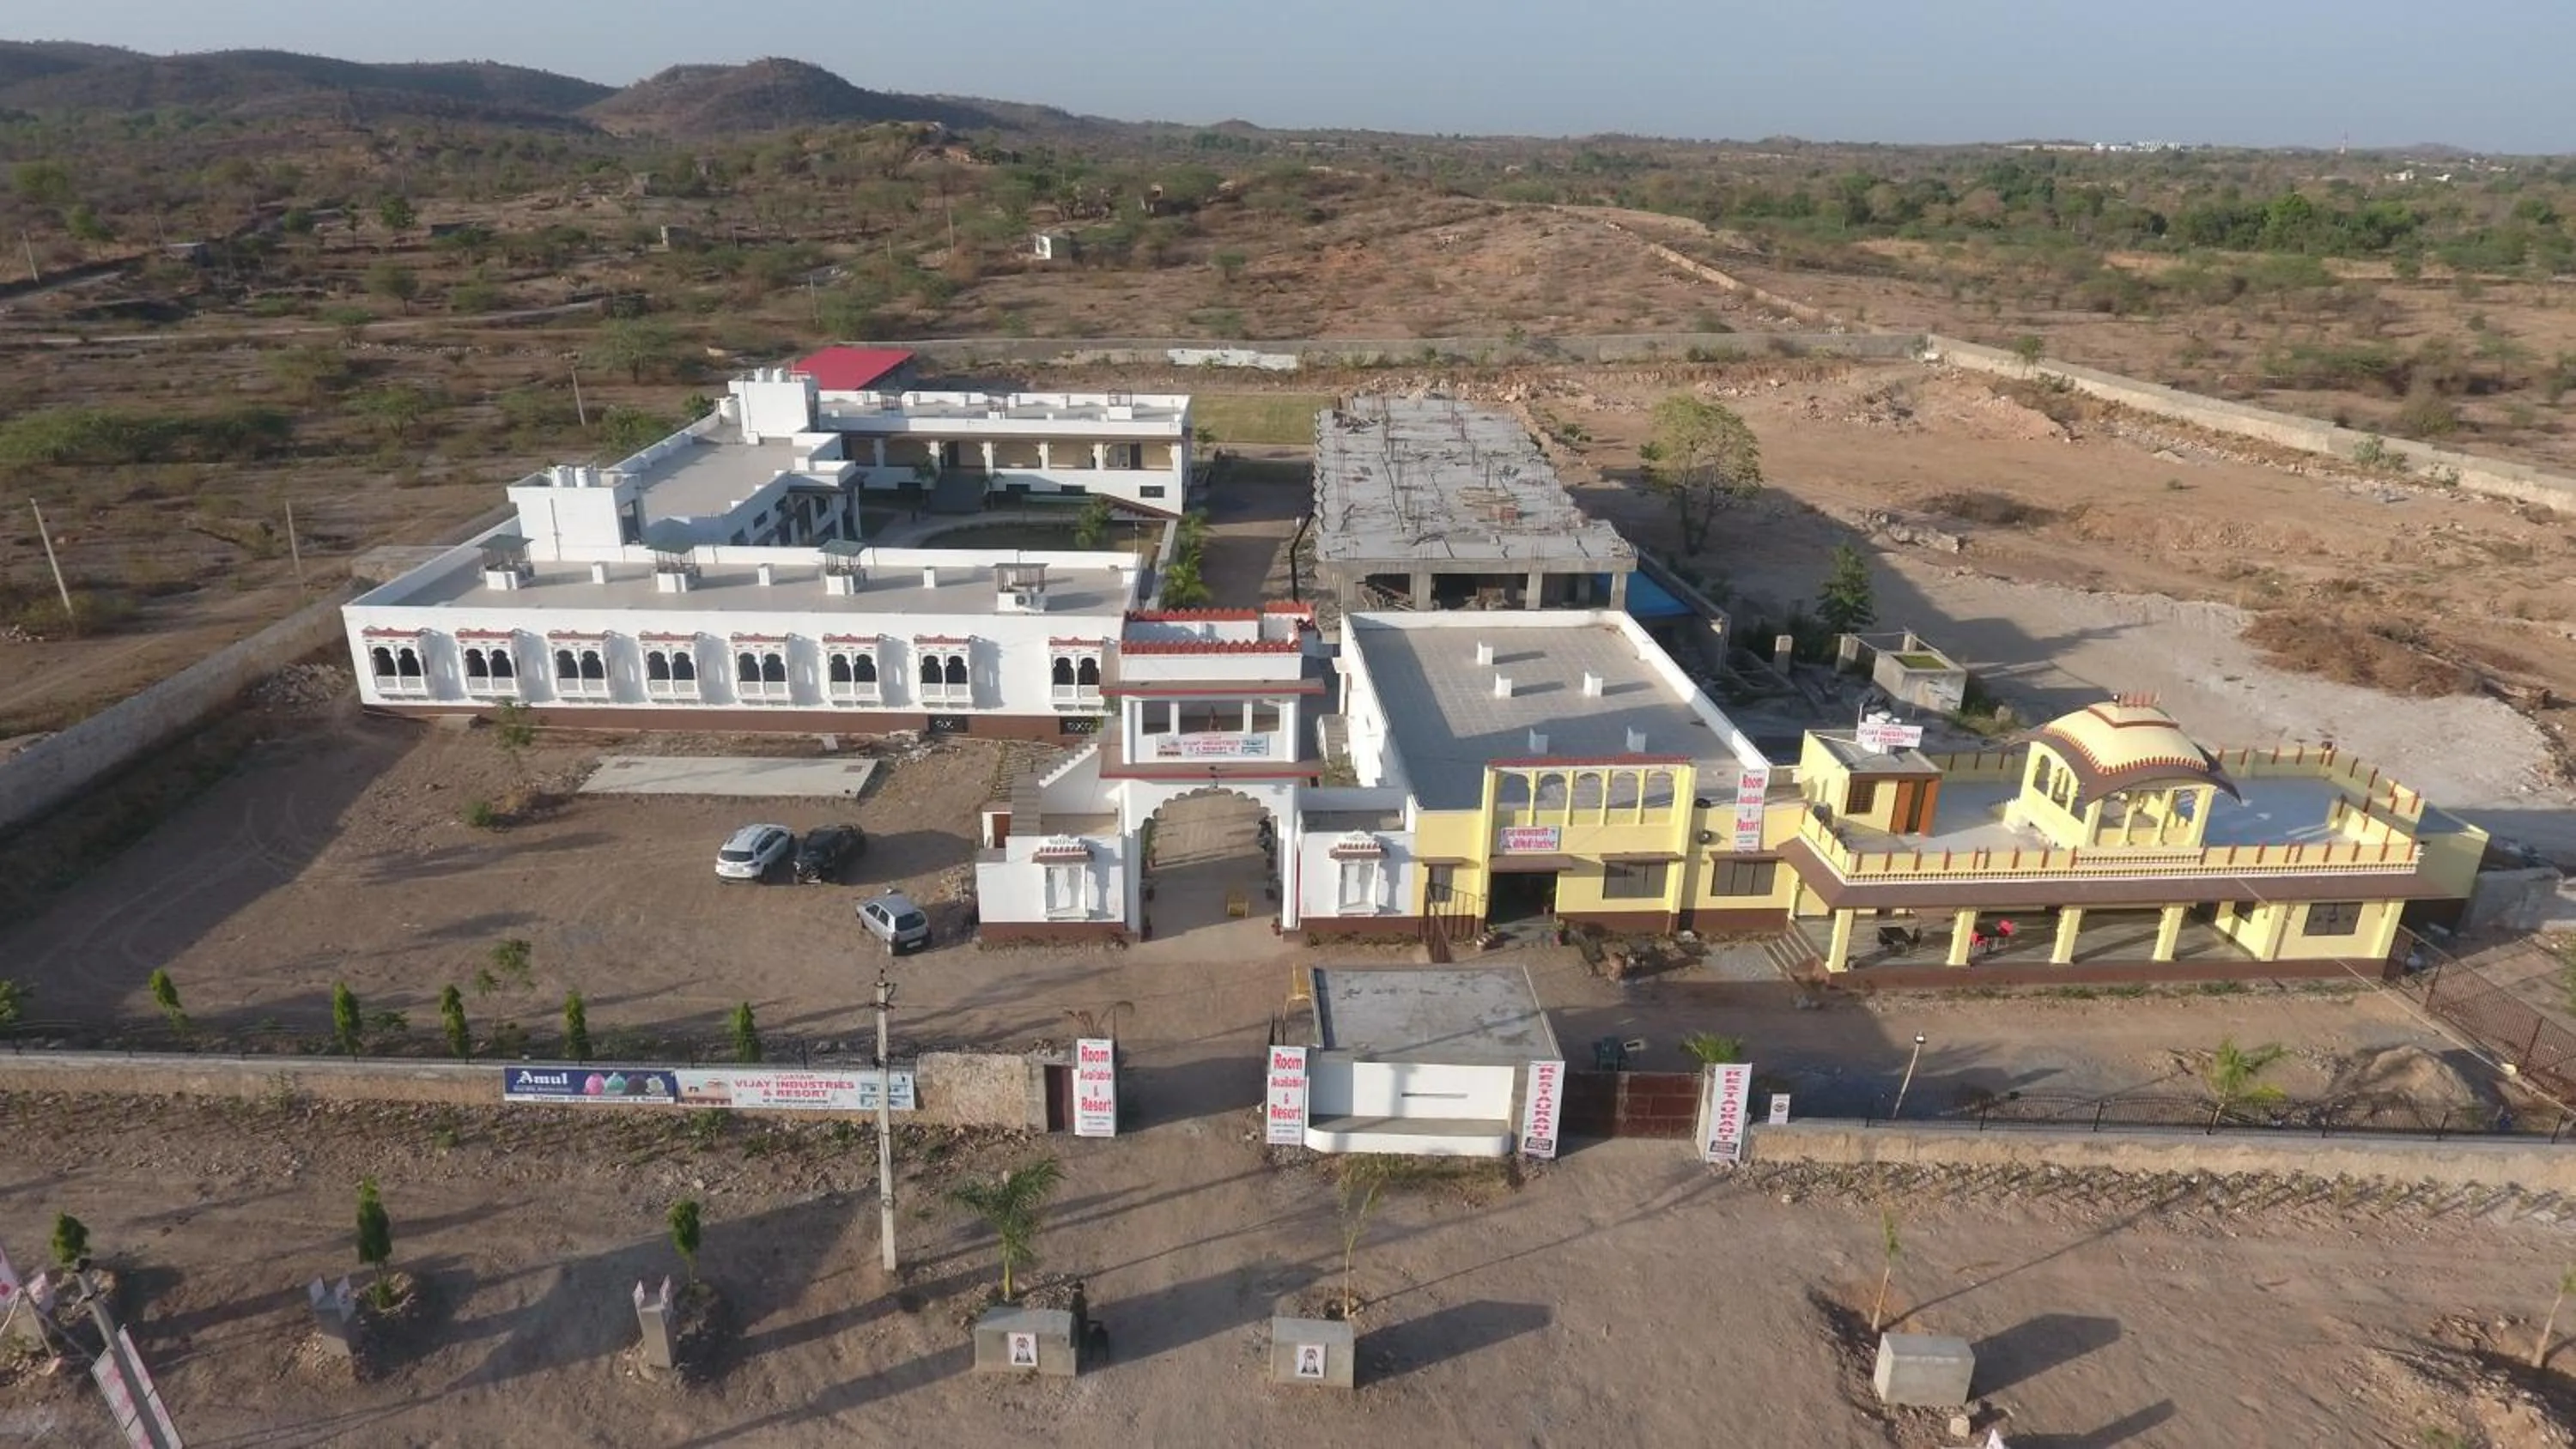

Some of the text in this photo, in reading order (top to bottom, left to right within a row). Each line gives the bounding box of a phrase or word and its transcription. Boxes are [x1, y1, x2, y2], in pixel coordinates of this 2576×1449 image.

[1081, 1045, 1109, 1063] Room
[1273, 1052, 1303, 1070] Room
[516, 1070, 568, 1085] Amul
[734, 1079, 855, 1090] VIJAY INDUSTRIES
[775, 1089, 829, 1098] RESORT
[1080, 1096, 1112, 1113] Resort
[1270, 1105, 1302, 1120] Resort
